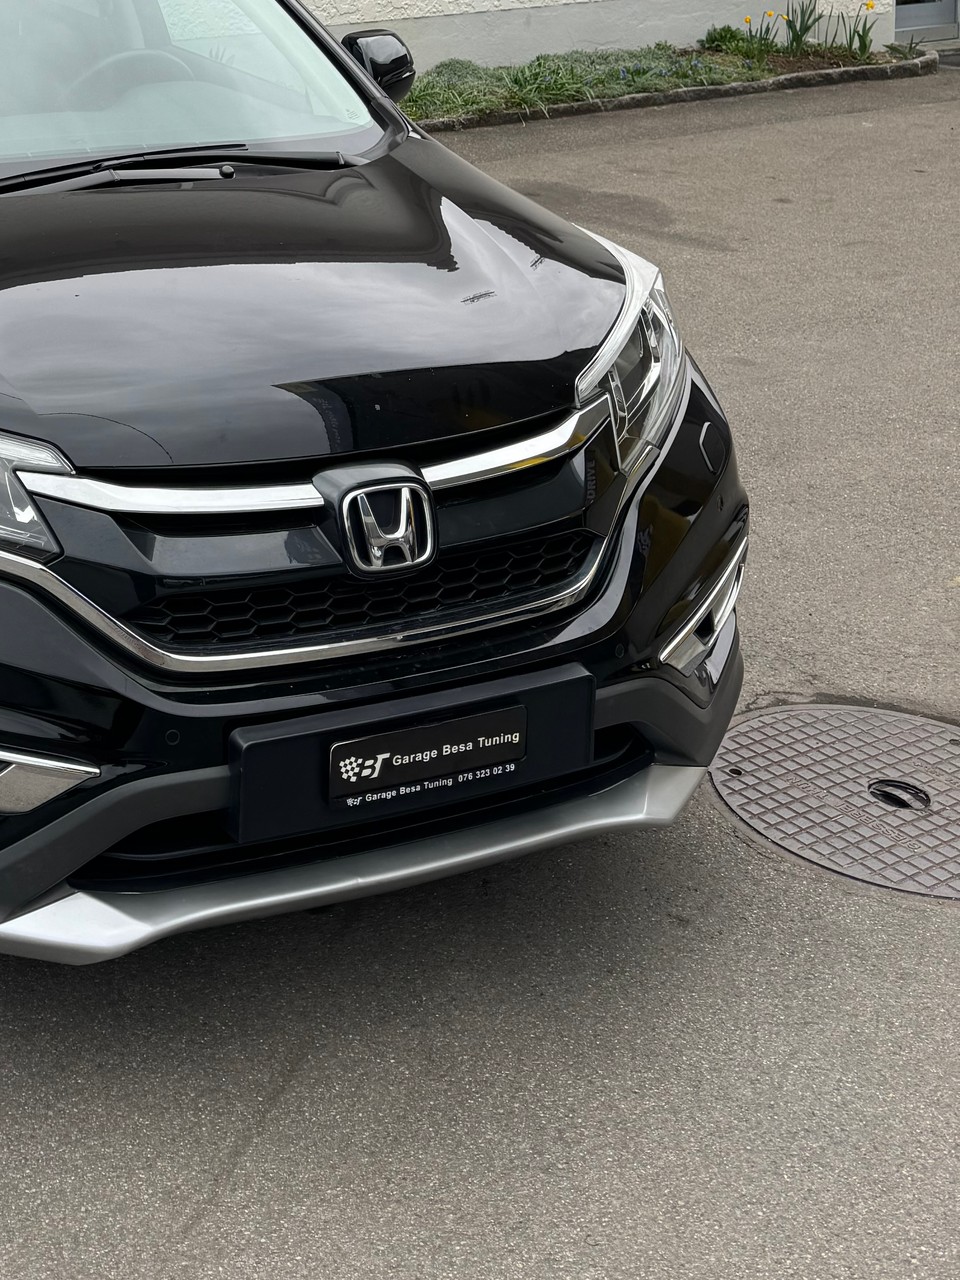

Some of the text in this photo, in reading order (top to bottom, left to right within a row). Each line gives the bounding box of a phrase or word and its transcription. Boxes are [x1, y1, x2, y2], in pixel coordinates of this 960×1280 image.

[392, 749, 438, 766] Garage
[442, 742, 473, 756] Besa
[478, 732, 520, 748] Tuning
[365, 790, 397, 802] Garage
[399, 785, 421, 795] Besa
[424, 778, 453, 789] Tuning
[458, 773, 473, 783] 076
[475, 769, 491, 779] 323
[492, 766, 503, 775] 02
[505, 763, 515, 773] 39
